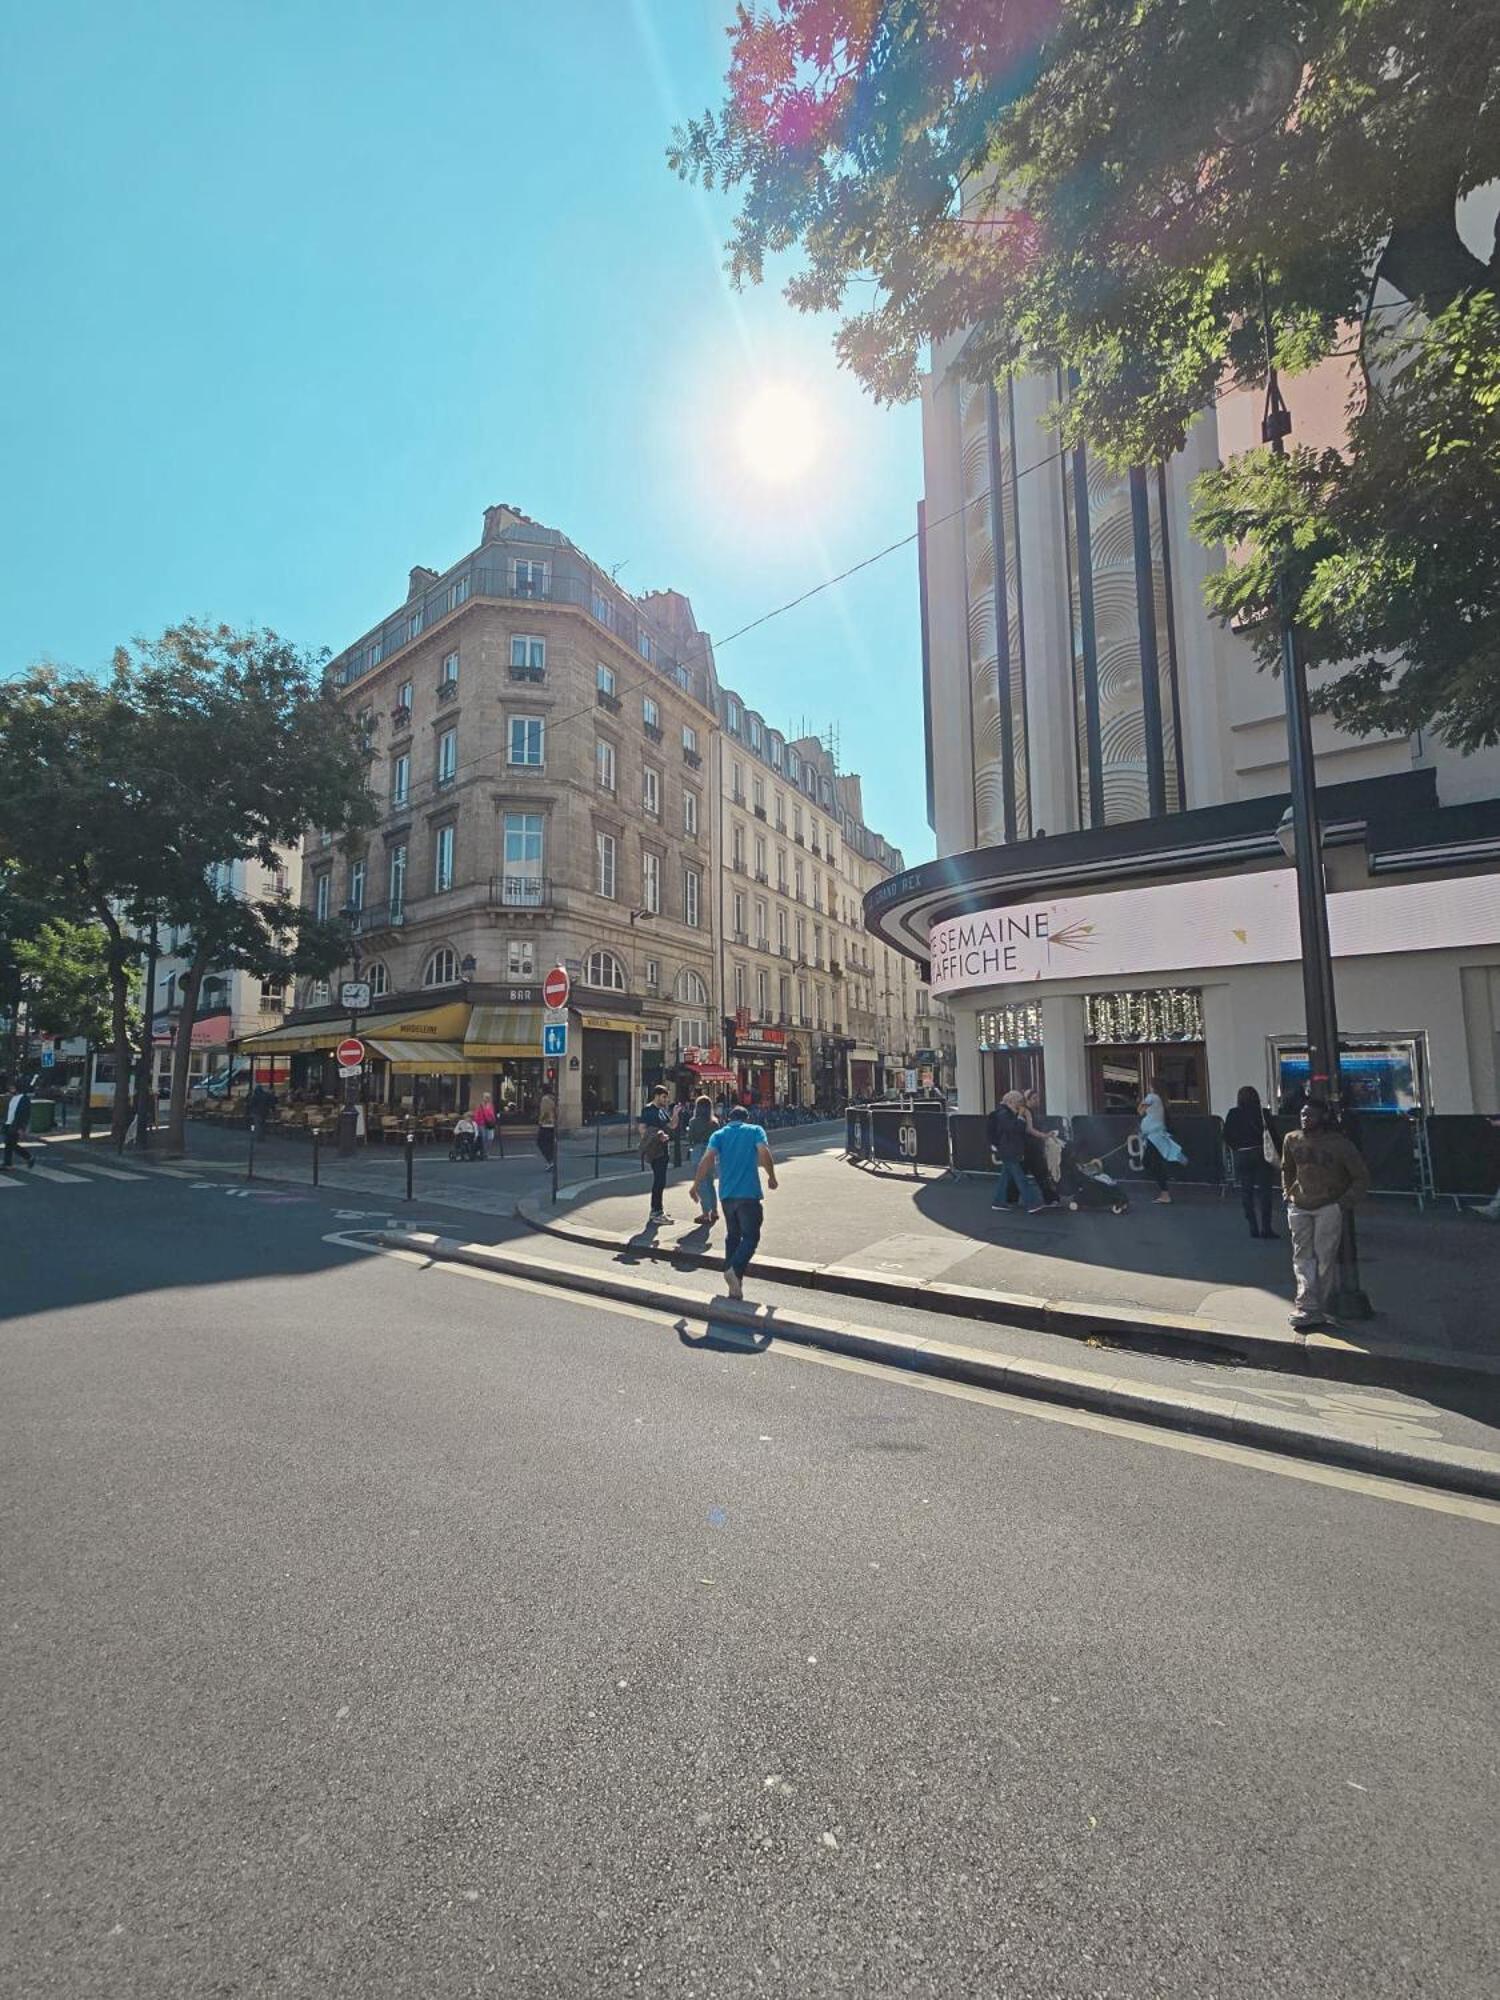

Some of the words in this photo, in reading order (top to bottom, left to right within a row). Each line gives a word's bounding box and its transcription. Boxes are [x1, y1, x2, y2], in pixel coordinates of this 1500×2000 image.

[902, 873, 921, 893] REX
[940, 912, 1049, 955] SEMAINE
[509, 989, 532, 1001] BAR
[898, 1126, 917, 1157] 90
[1127, 1134, 1148, 1171] 9
